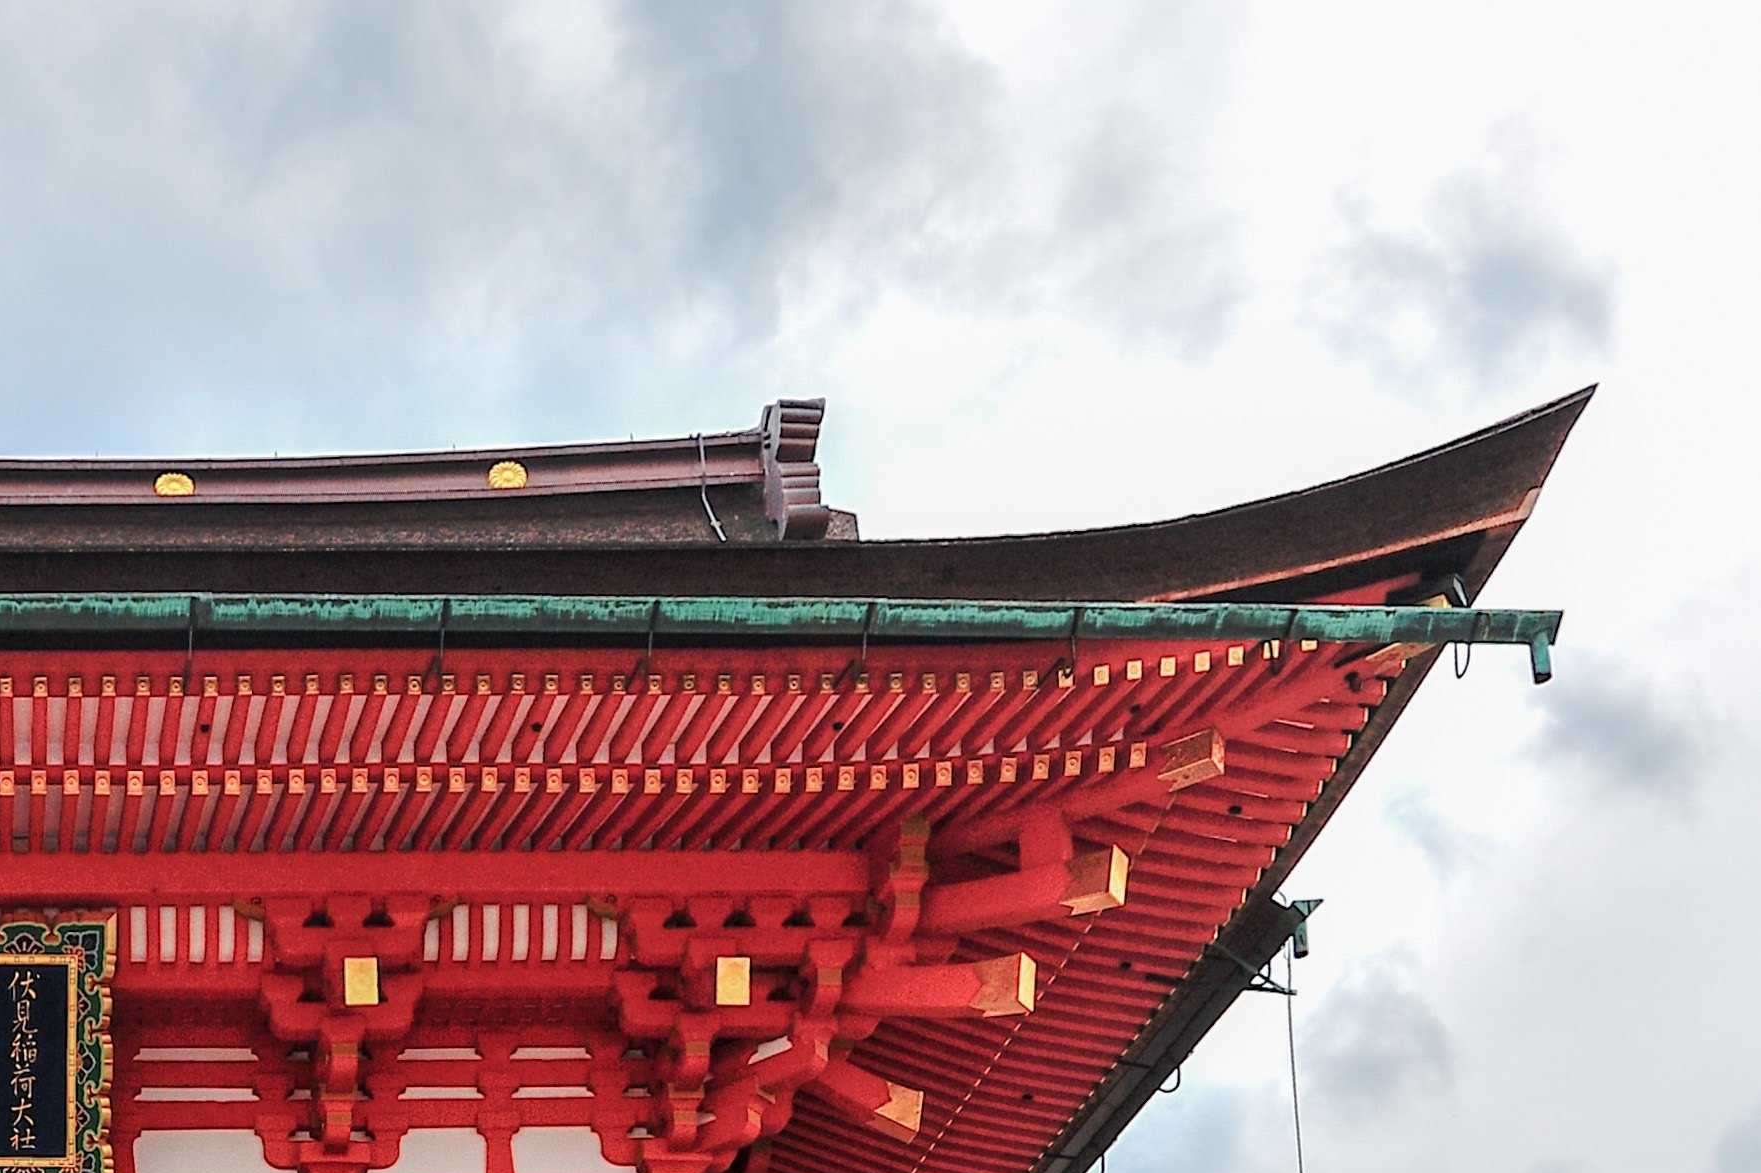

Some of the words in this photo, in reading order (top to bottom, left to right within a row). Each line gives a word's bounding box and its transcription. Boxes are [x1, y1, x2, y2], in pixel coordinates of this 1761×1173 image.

[8, 971, 40, 1150] 伏見稲荷大社
